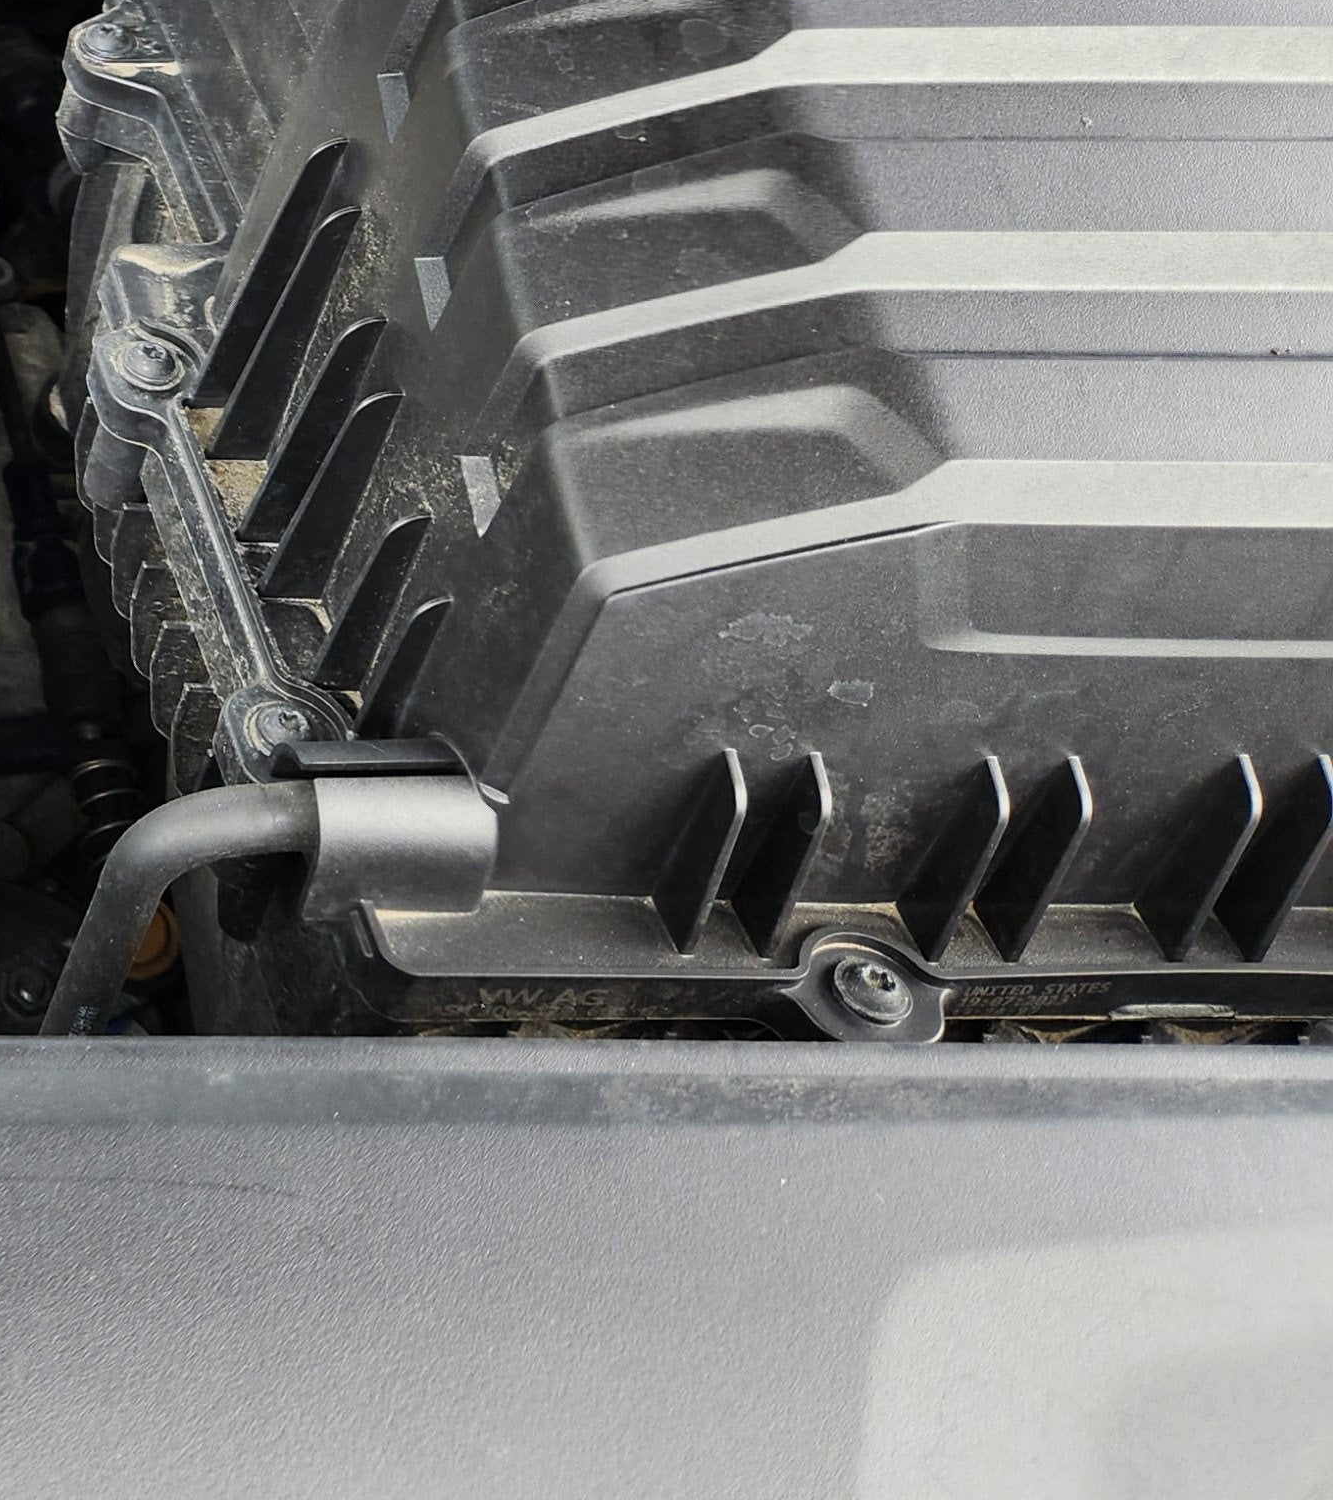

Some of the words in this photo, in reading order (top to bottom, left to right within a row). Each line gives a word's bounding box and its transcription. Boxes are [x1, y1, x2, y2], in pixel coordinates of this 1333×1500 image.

[478, 987, 544, 1005] VW
[552, 987, 609, 1006] AG
[964, 983, 1033, 996] UNITED
[1043, 980, 1111, 996] STATES
